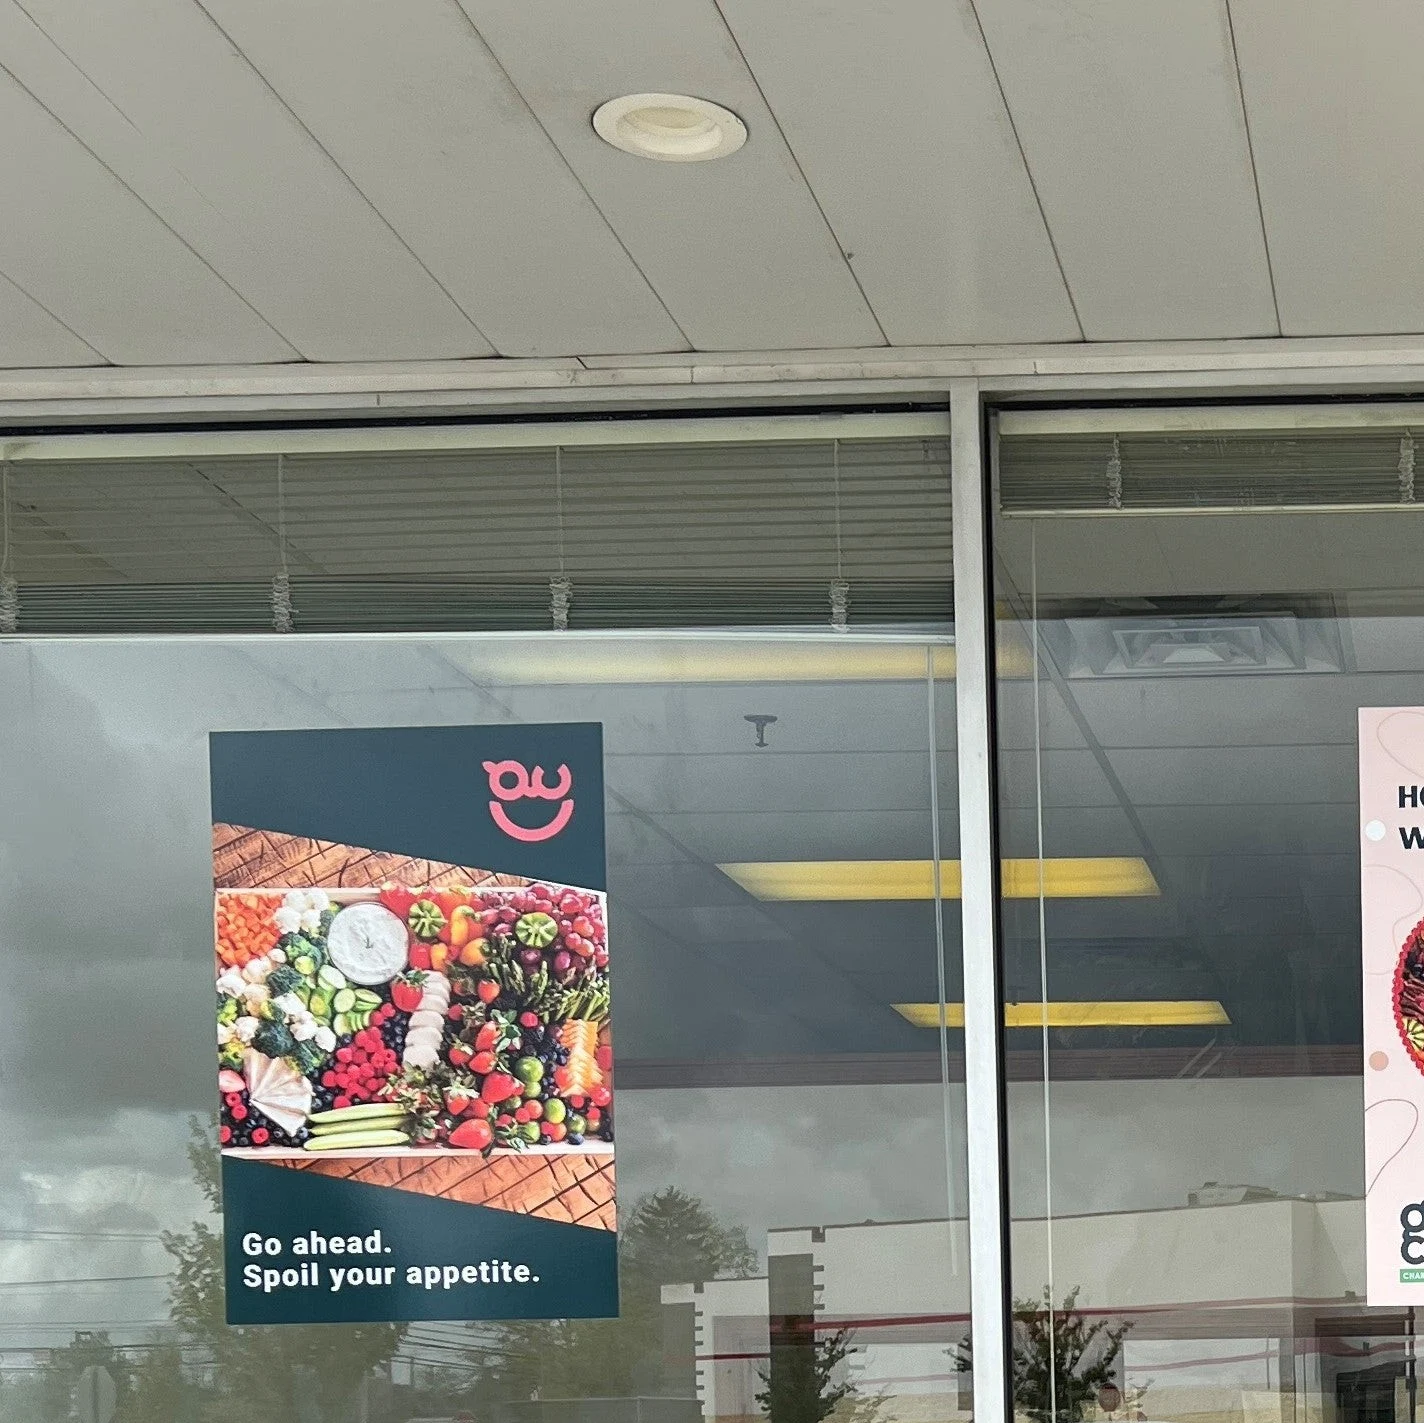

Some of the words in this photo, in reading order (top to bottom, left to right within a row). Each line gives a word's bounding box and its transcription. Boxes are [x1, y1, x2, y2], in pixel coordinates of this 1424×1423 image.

[242, 1231, 282, 1256] Go
[292, 1230, 392, 1255] ahead.
[243, 1262, 319, 1293] Spoil
[329, 1264, 395, 1292] your
[406, 1259, 540, 1290] appetite.
